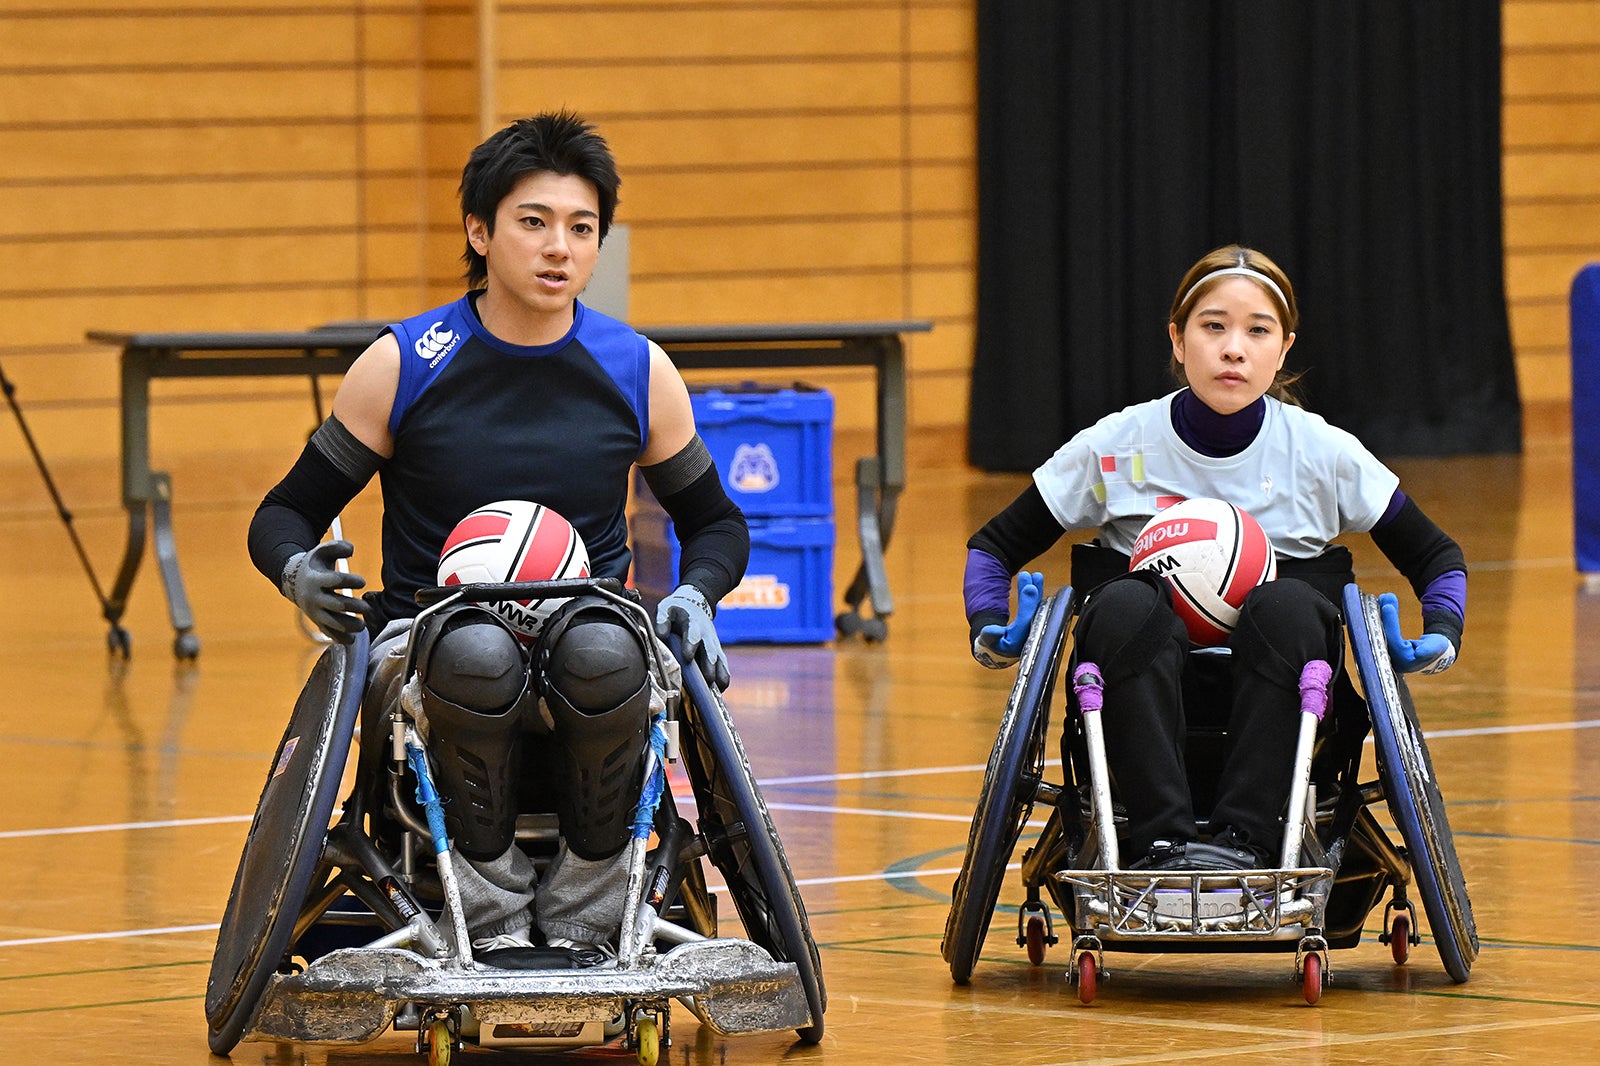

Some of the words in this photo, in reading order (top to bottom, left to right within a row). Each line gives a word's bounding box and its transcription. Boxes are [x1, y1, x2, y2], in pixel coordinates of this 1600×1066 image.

[429, 333, 460, 368] canterbury
[1131, 522, 1189, 560] molte
[1166, 898, 1237, 917] rhno
